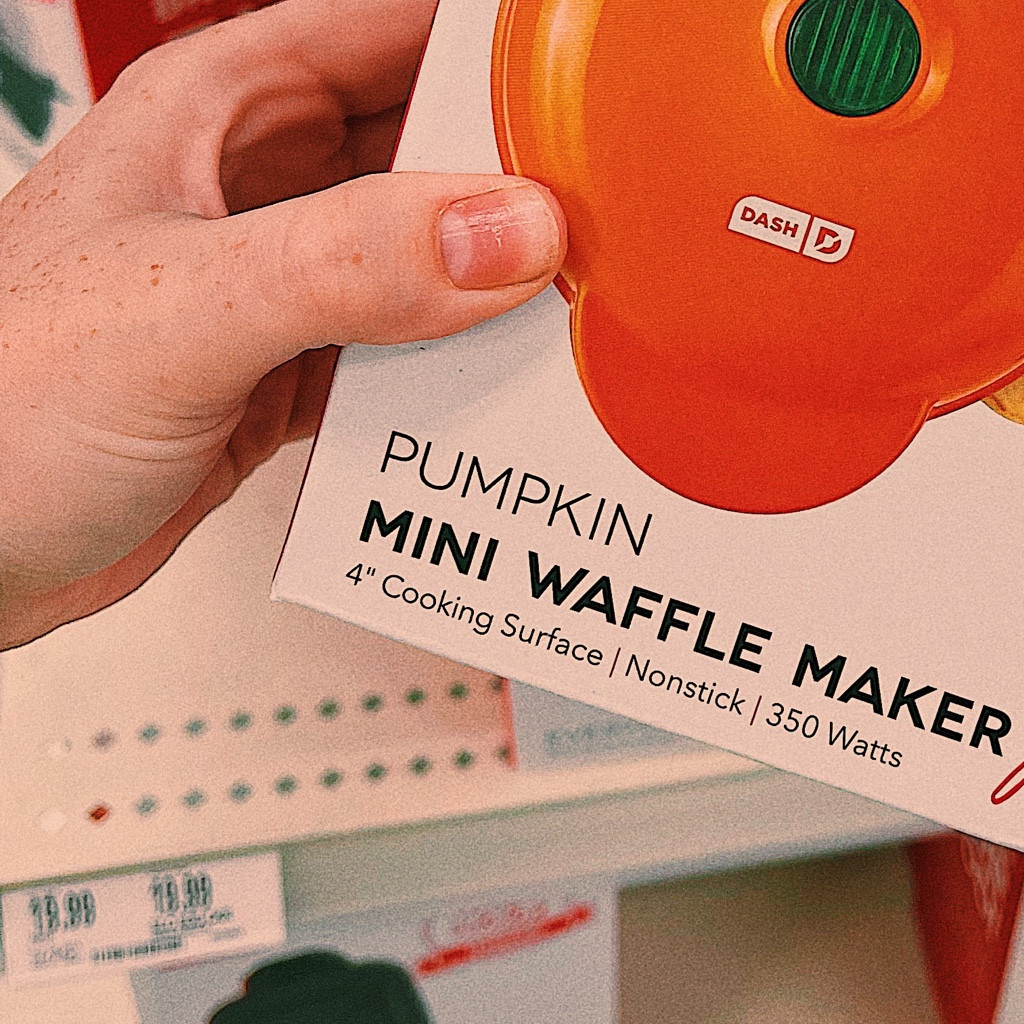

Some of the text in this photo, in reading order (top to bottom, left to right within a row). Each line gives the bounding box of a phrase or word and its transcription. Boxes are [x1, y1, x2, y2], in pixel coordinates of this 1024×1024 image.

[740, 205, 800, 239] DASH
[379, 429, 654, 557] PUMPKIN
[345, 562, 377, 587] 4"
[381, 572, 495, 637] Cooking
[500, 612, 604, 667] Surface
[624, 652, 747, 717] Nonstick
[765, 700, 820, 740] 350
[827, 719, 904, 770] Watts
[358, 498, 1013, 758] MINI WAFFLE MAKER
